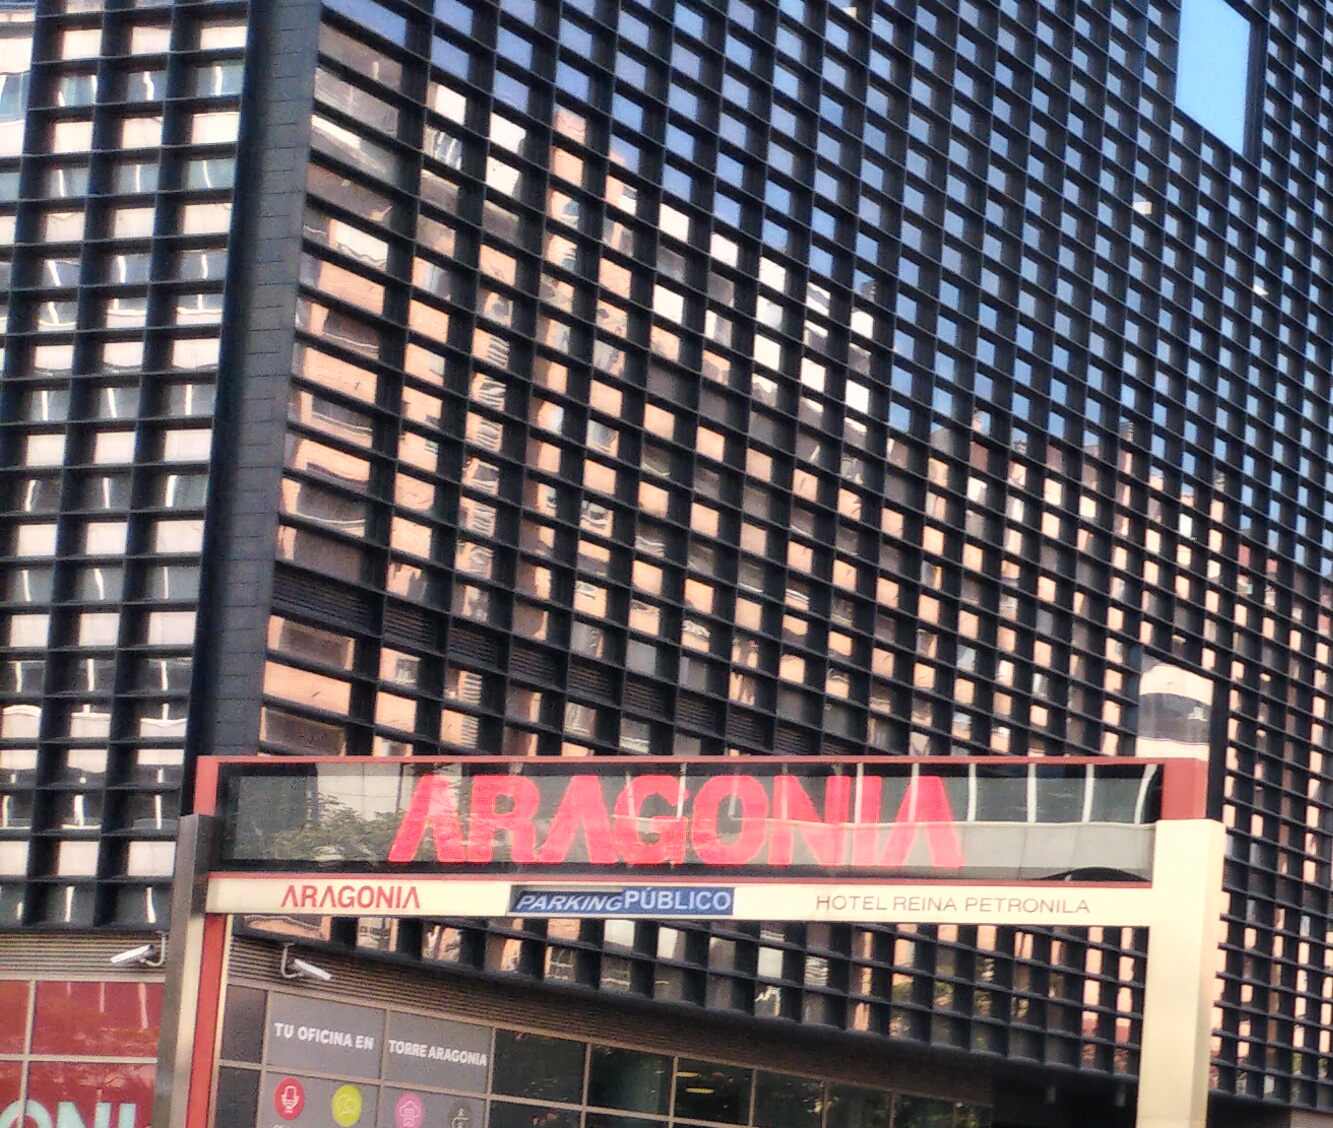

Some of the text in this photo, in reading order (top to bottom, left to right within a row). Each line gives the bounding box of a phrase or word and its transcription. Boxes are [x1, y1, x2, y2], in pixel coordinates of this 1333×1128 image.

[387, 775, 964, 867] ARAGONIA
[281, 885, 1091, 914] ARAGONIA PARKING PÚBLICO HOTEL REINA PETRONILA
[274, 1022, 488, 1067] TU OFICINA EN TORRE ARAGONIA
